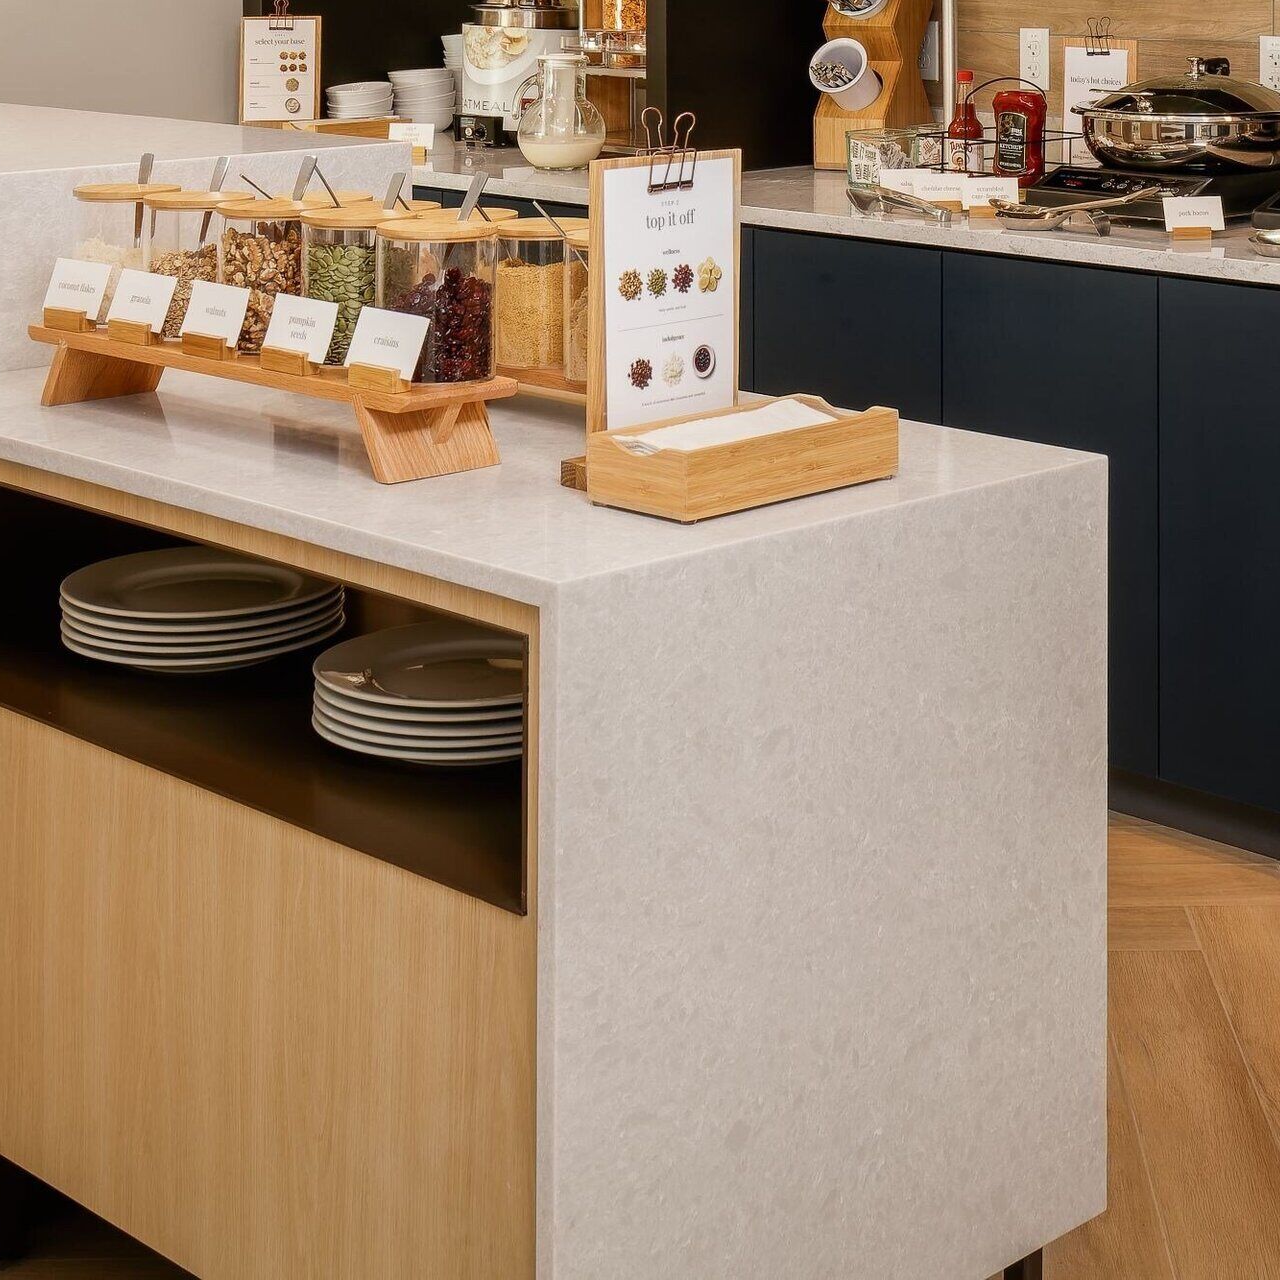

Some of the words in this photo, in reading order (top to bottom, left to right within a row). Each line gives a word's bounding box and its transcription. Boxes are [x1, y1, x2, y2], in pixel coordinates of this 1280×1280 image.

[274, 39, 290, 47] your
[1071, 76, 1090, 86] today's
[1091, 76, 1100, 85] hot
[1101, 77, 1122, 86] choices
[646, 215, 665, 231] top
[668, 211, 676, 226] it
[679, 208, 696, 225] off
[58, 279, 80, 291] coconut
[80, 281, 96, 294] flakes
[130, 294, 152, 305] granola
[205, 305, 227, 318] walnuts
[288, 315, 317, 327] pumpkin
[290, 330, 307, 340] seeds
[373, 334, 401, 349] craisins
